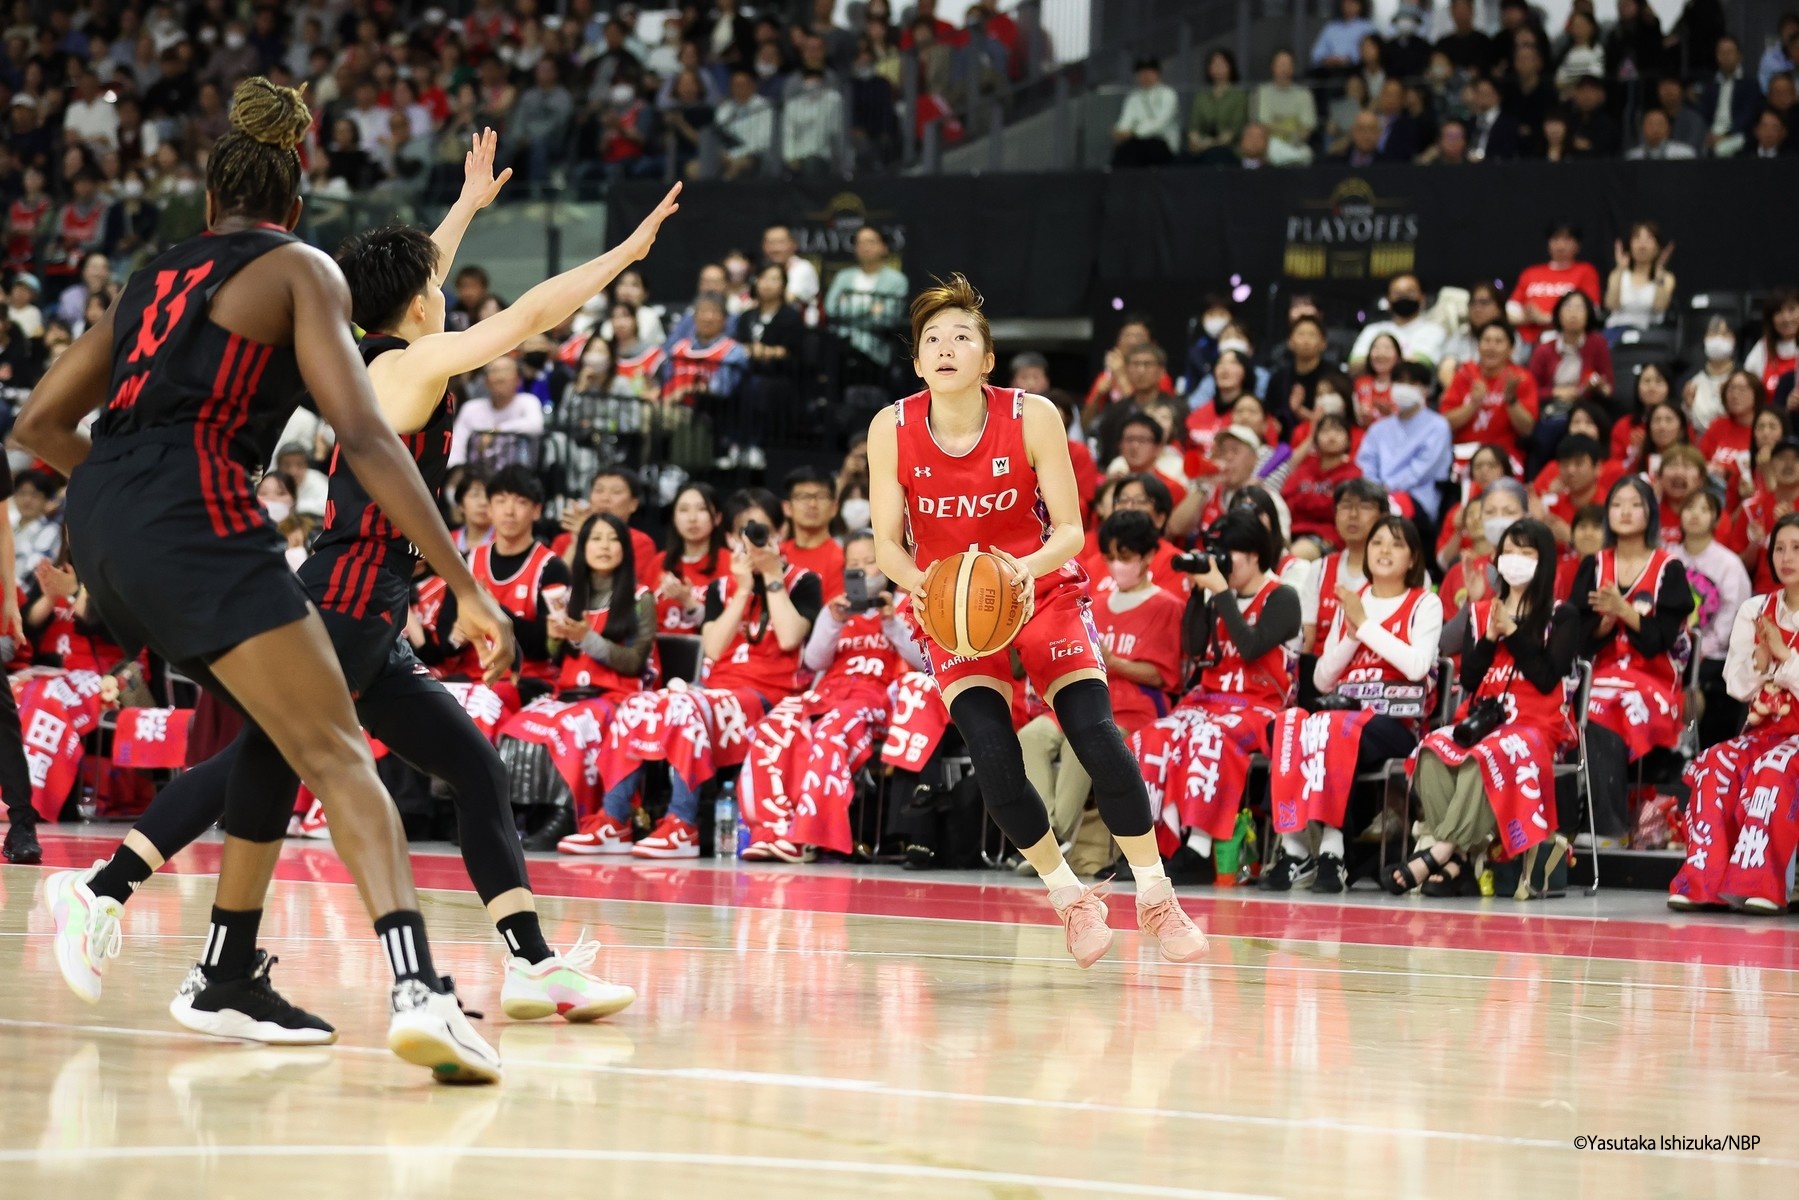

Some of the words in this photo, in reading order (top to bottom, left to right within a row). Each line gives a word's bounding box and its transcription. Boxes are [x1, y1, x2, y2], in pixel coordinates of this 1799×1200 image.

[1286, 213, 1419, 243] PLAYOFFS
[917, 488, 1018, 518] DENSO
[983, 588, 996, 613] FIBA
[1218, 667, 1245, 693] 11
[1279, 800, 1298, 829] 23
